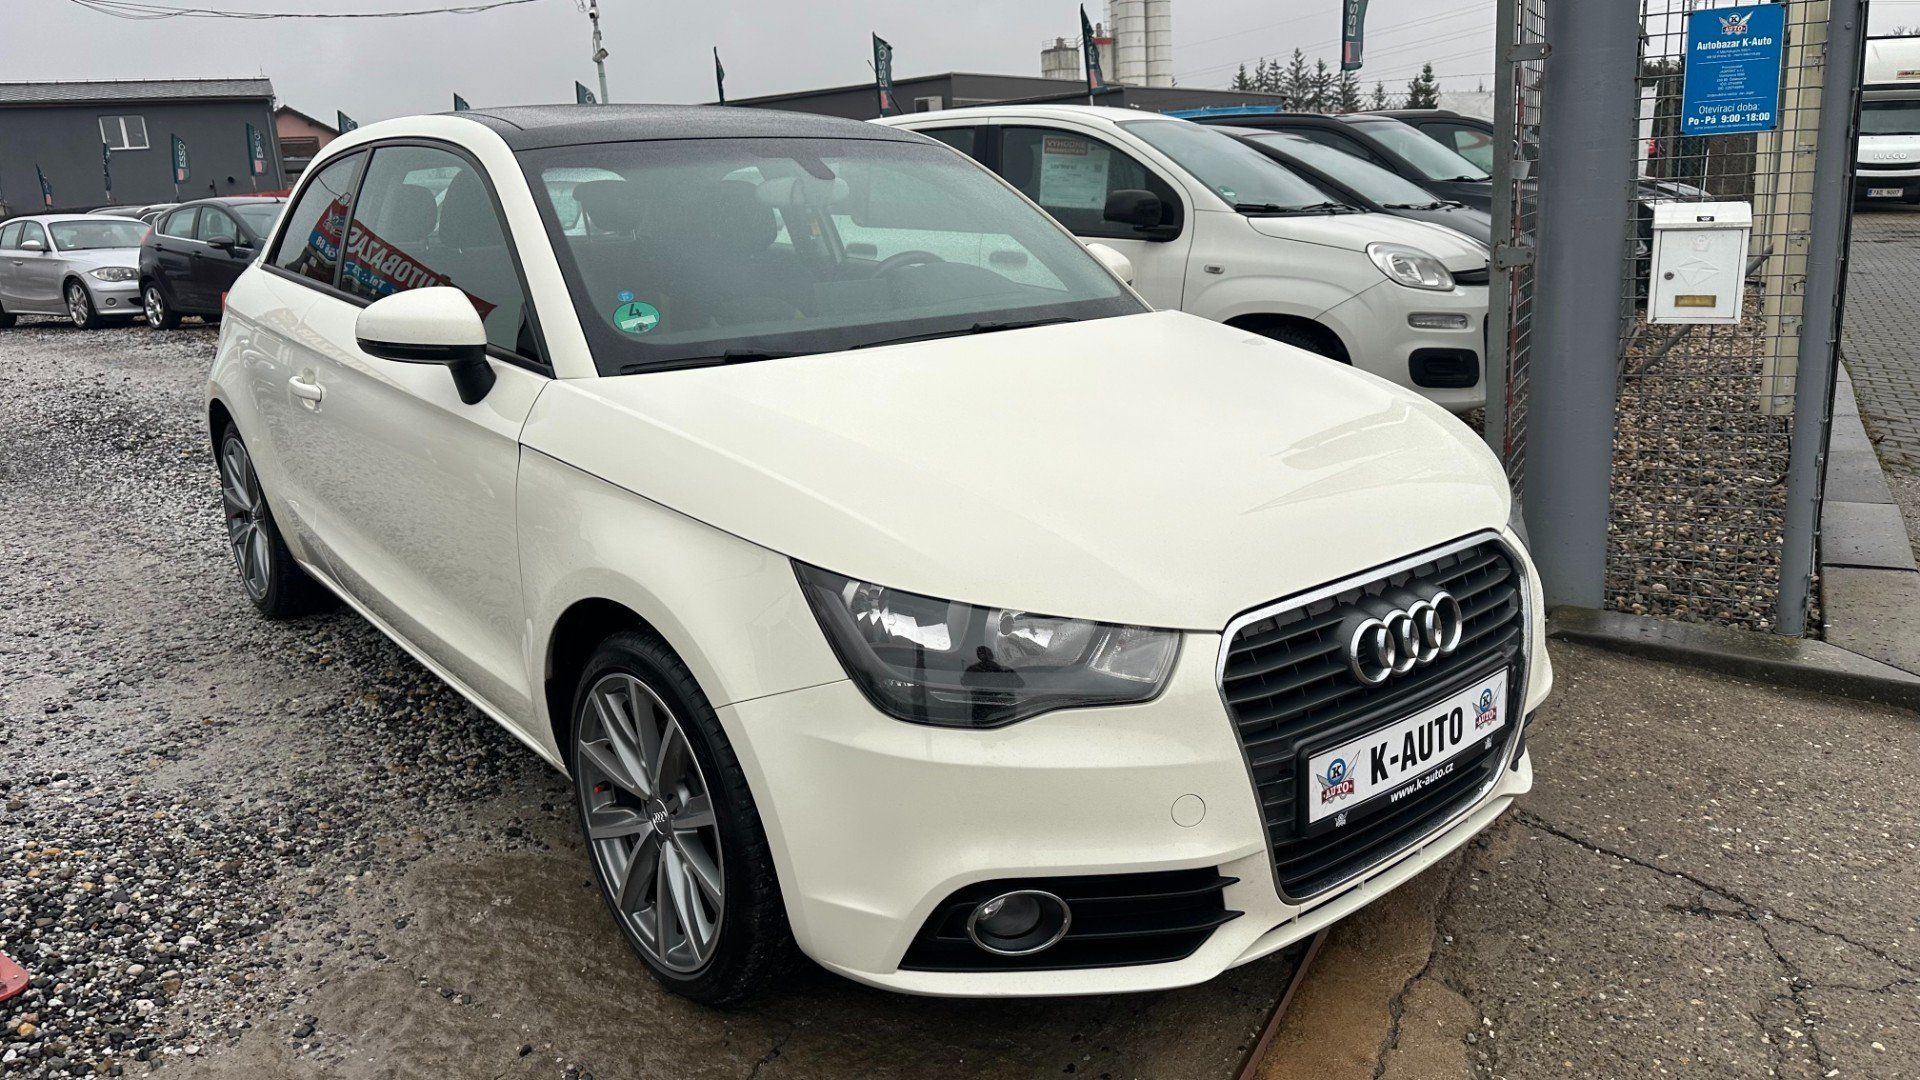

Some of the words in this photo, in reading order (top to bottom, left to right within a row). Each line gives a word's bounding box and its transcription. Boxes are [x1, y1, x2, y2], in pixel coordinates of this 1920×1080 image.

[1347, 0, 1358, 36] ESS
[1697, 40, 1740, 51] Autobazar
[1742, 37, 1772, 47] K-Auto
[1737, 103, 1760, 111] doba:
[1688, 117, 1699, 126] Po
[1705, 116, 1716, 124] Pá
[1721, 114, 1740, 123] 9:00
[1745, 112, 1770, 122] 18:00
[1874, 152, 1907, 160] IVECO
[629, 303, 642, 316] 4
[1478, 709, 1495, 725] AUTO
[1371, 706, 1464, 786] K-AUTO
[1331, 765, 1342, 778] K
[1390, 761, 1455, 803] www.k-auto.cz
[1325, 781, 1350, 802] AUTO
